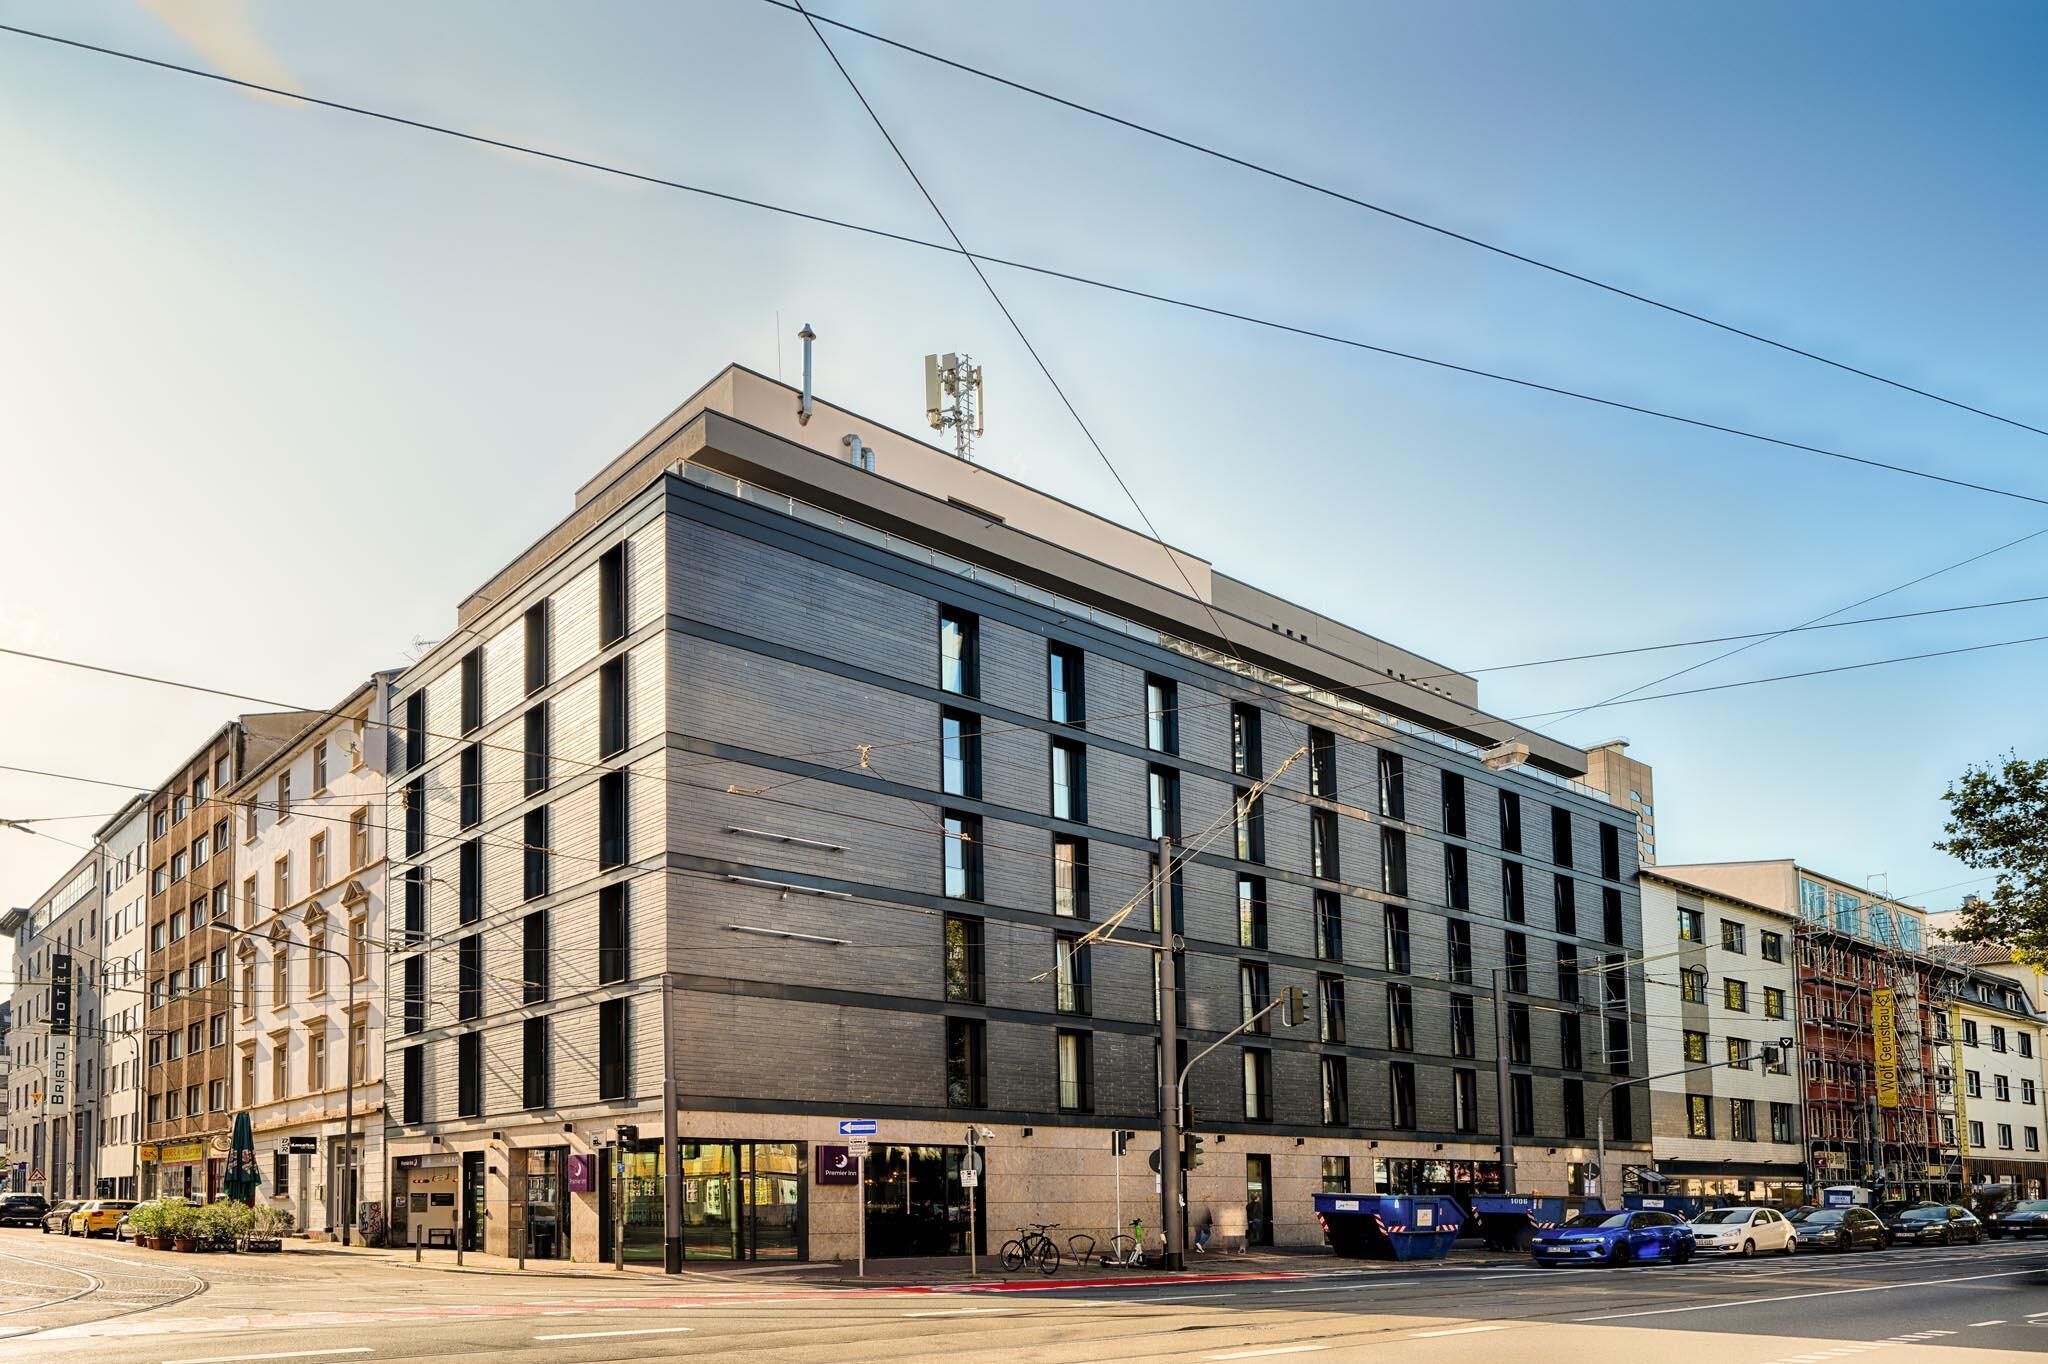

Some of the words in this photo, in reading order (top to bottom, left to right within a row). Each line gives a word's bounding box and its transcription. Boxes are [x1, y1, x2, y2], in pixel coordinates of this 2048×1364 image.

[57, 962, 67, 1031] HOTEL
[1879, 1008, 1892, 1062] Gerüstbau
[1880, 1064, 1894, 1093] Wolf
